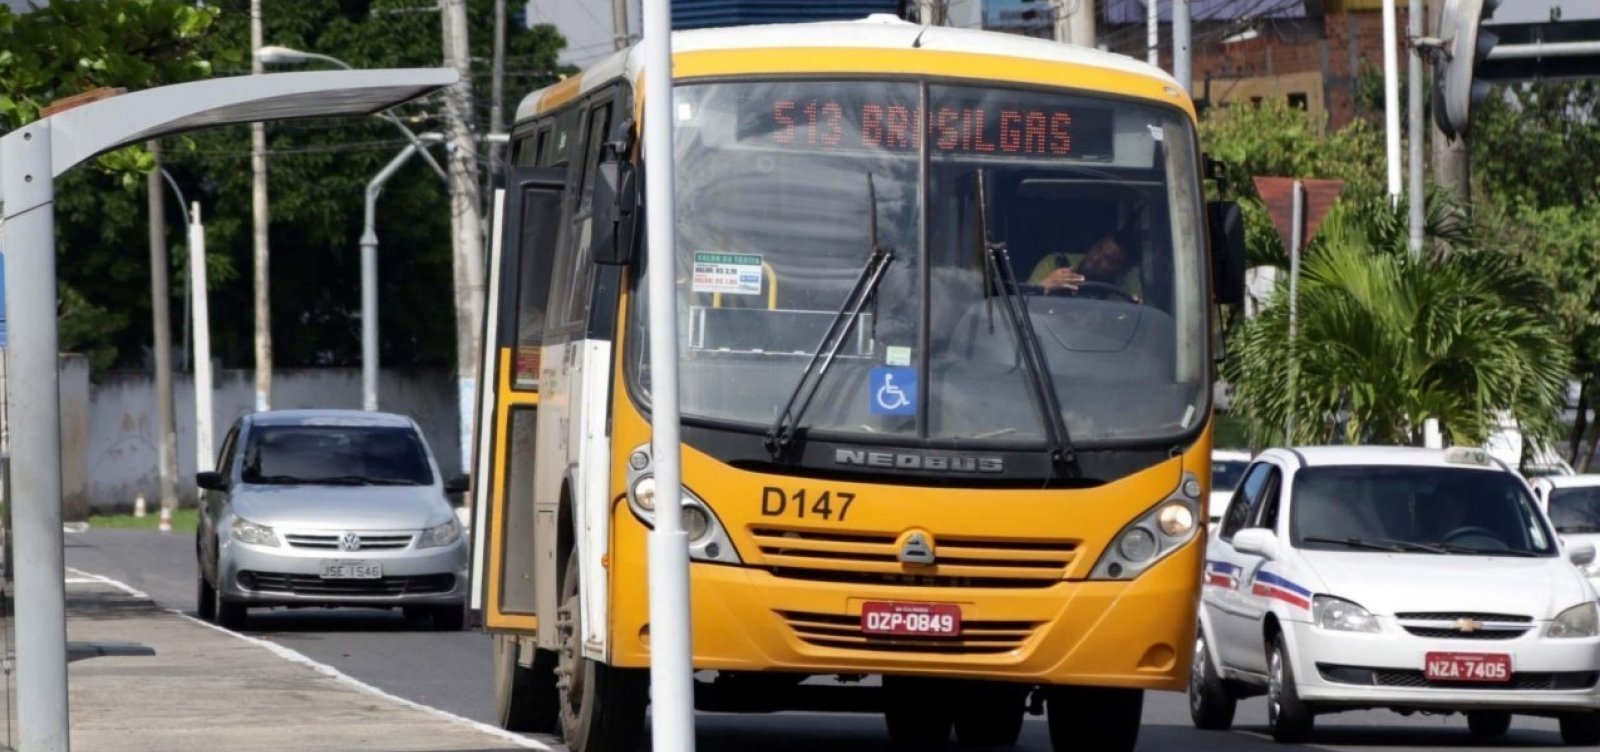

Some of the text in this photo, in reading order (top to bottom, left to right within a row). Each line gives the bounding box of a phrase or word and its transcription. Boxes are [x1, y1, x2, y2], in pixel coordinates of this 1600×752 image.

[773, 100, 842, 145] 513
[836, 449, 1004, 472] NEOBUS
[761, 487, 856, 521] D147
